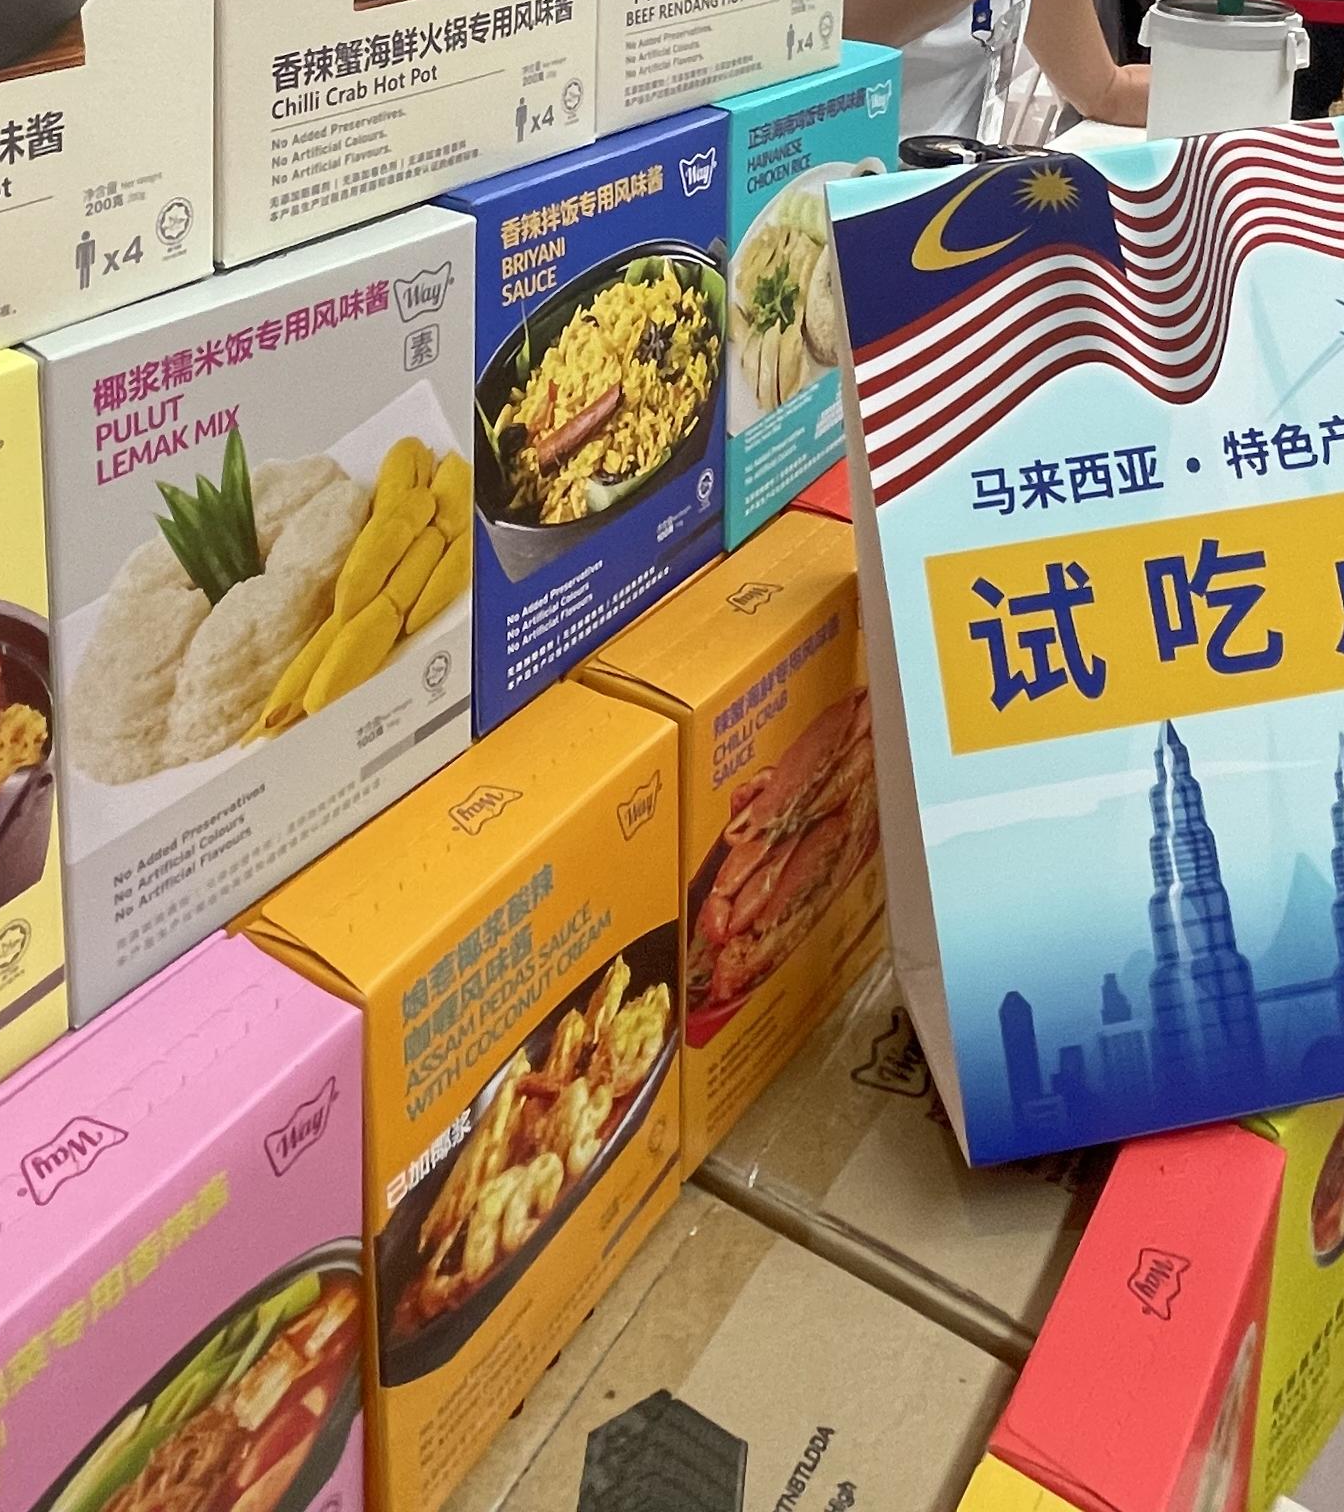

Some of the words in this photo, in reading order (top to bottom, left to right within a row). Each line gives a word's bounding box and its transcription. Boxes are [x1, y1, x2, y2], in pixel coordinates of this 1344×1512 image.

[625, 6, 656, 27] BEEF
[271, 90, 320, 120] Chilli
[326, 79, 368, 107] Crab
[374, 72, 406, 96] Hot
[410, 65, 438, 87] Pot
[271, 139, 288, 151] No
[292, 126, 328, 147] Added
[530, 105, 555, 133] x4
[271, 156, 288, 169] No
[292, 141, 342, 165] Artificial
[271, 174, 288, 187] No
[292, 158, 341, 182] Artificial
[747, 163, 791, 195] CHICKEN
[792, 152, 813, 174] RICE
[85, 194, 124, 217] 200克
[500, 164, 666, 251] 香辣拌饭专用风味酱
[102, 235, 144, 275] x4
[501, 236, 567, 282] BRIYANI
[402, 280, 442, 312] Way
[501, 268, 558, 308] SAUCE
[92, 279, 391, 417] 椰浆糯米饭专用风味酱
[409, 331, 435, 367] 素
[96, 394, 185, 452] PULUT
[96, 425, 190, 487] LEMAK
[194, 403, 242, 447] MIX
[507, 613, 520, 627] No
[521, 593, 549, 619] Added
[507, 627, 520, 641] No
[521, 601, 560, 633] Artificial
[507, 641, 521, 655] No
[521, 615, 560, 647] Artificial
[713, 719, 754, 767] CHILLI
[756, 688, 789, 731] CRAB
[712, 740, 756, 791] SAUCE
[113, 869, 133, 888] No
[136, 837, 178, 874] Added
[181, 782, 267, 844] Preservatives
[113, 887, 133, 906] No
[138, 844, 196, 891] Artificial
[199, 813, 246, 850] Colours
[114, 905, 135, 923] No
[138, 861, 197, 909] Artificial
[200, 826, 253, 868] Flavours
[406, 1011, 479, 1097] ASSAM
[479, 957, 537, 1025] PEDAS
[538, 898, 594, 964] SAUCE
[406, 1047, 462, 1122] WITH
[464, 970, 555, 1069] COCONUT
[556, 909, 614, 977] CREAM
[31, 1130, 104, 1180] Way
